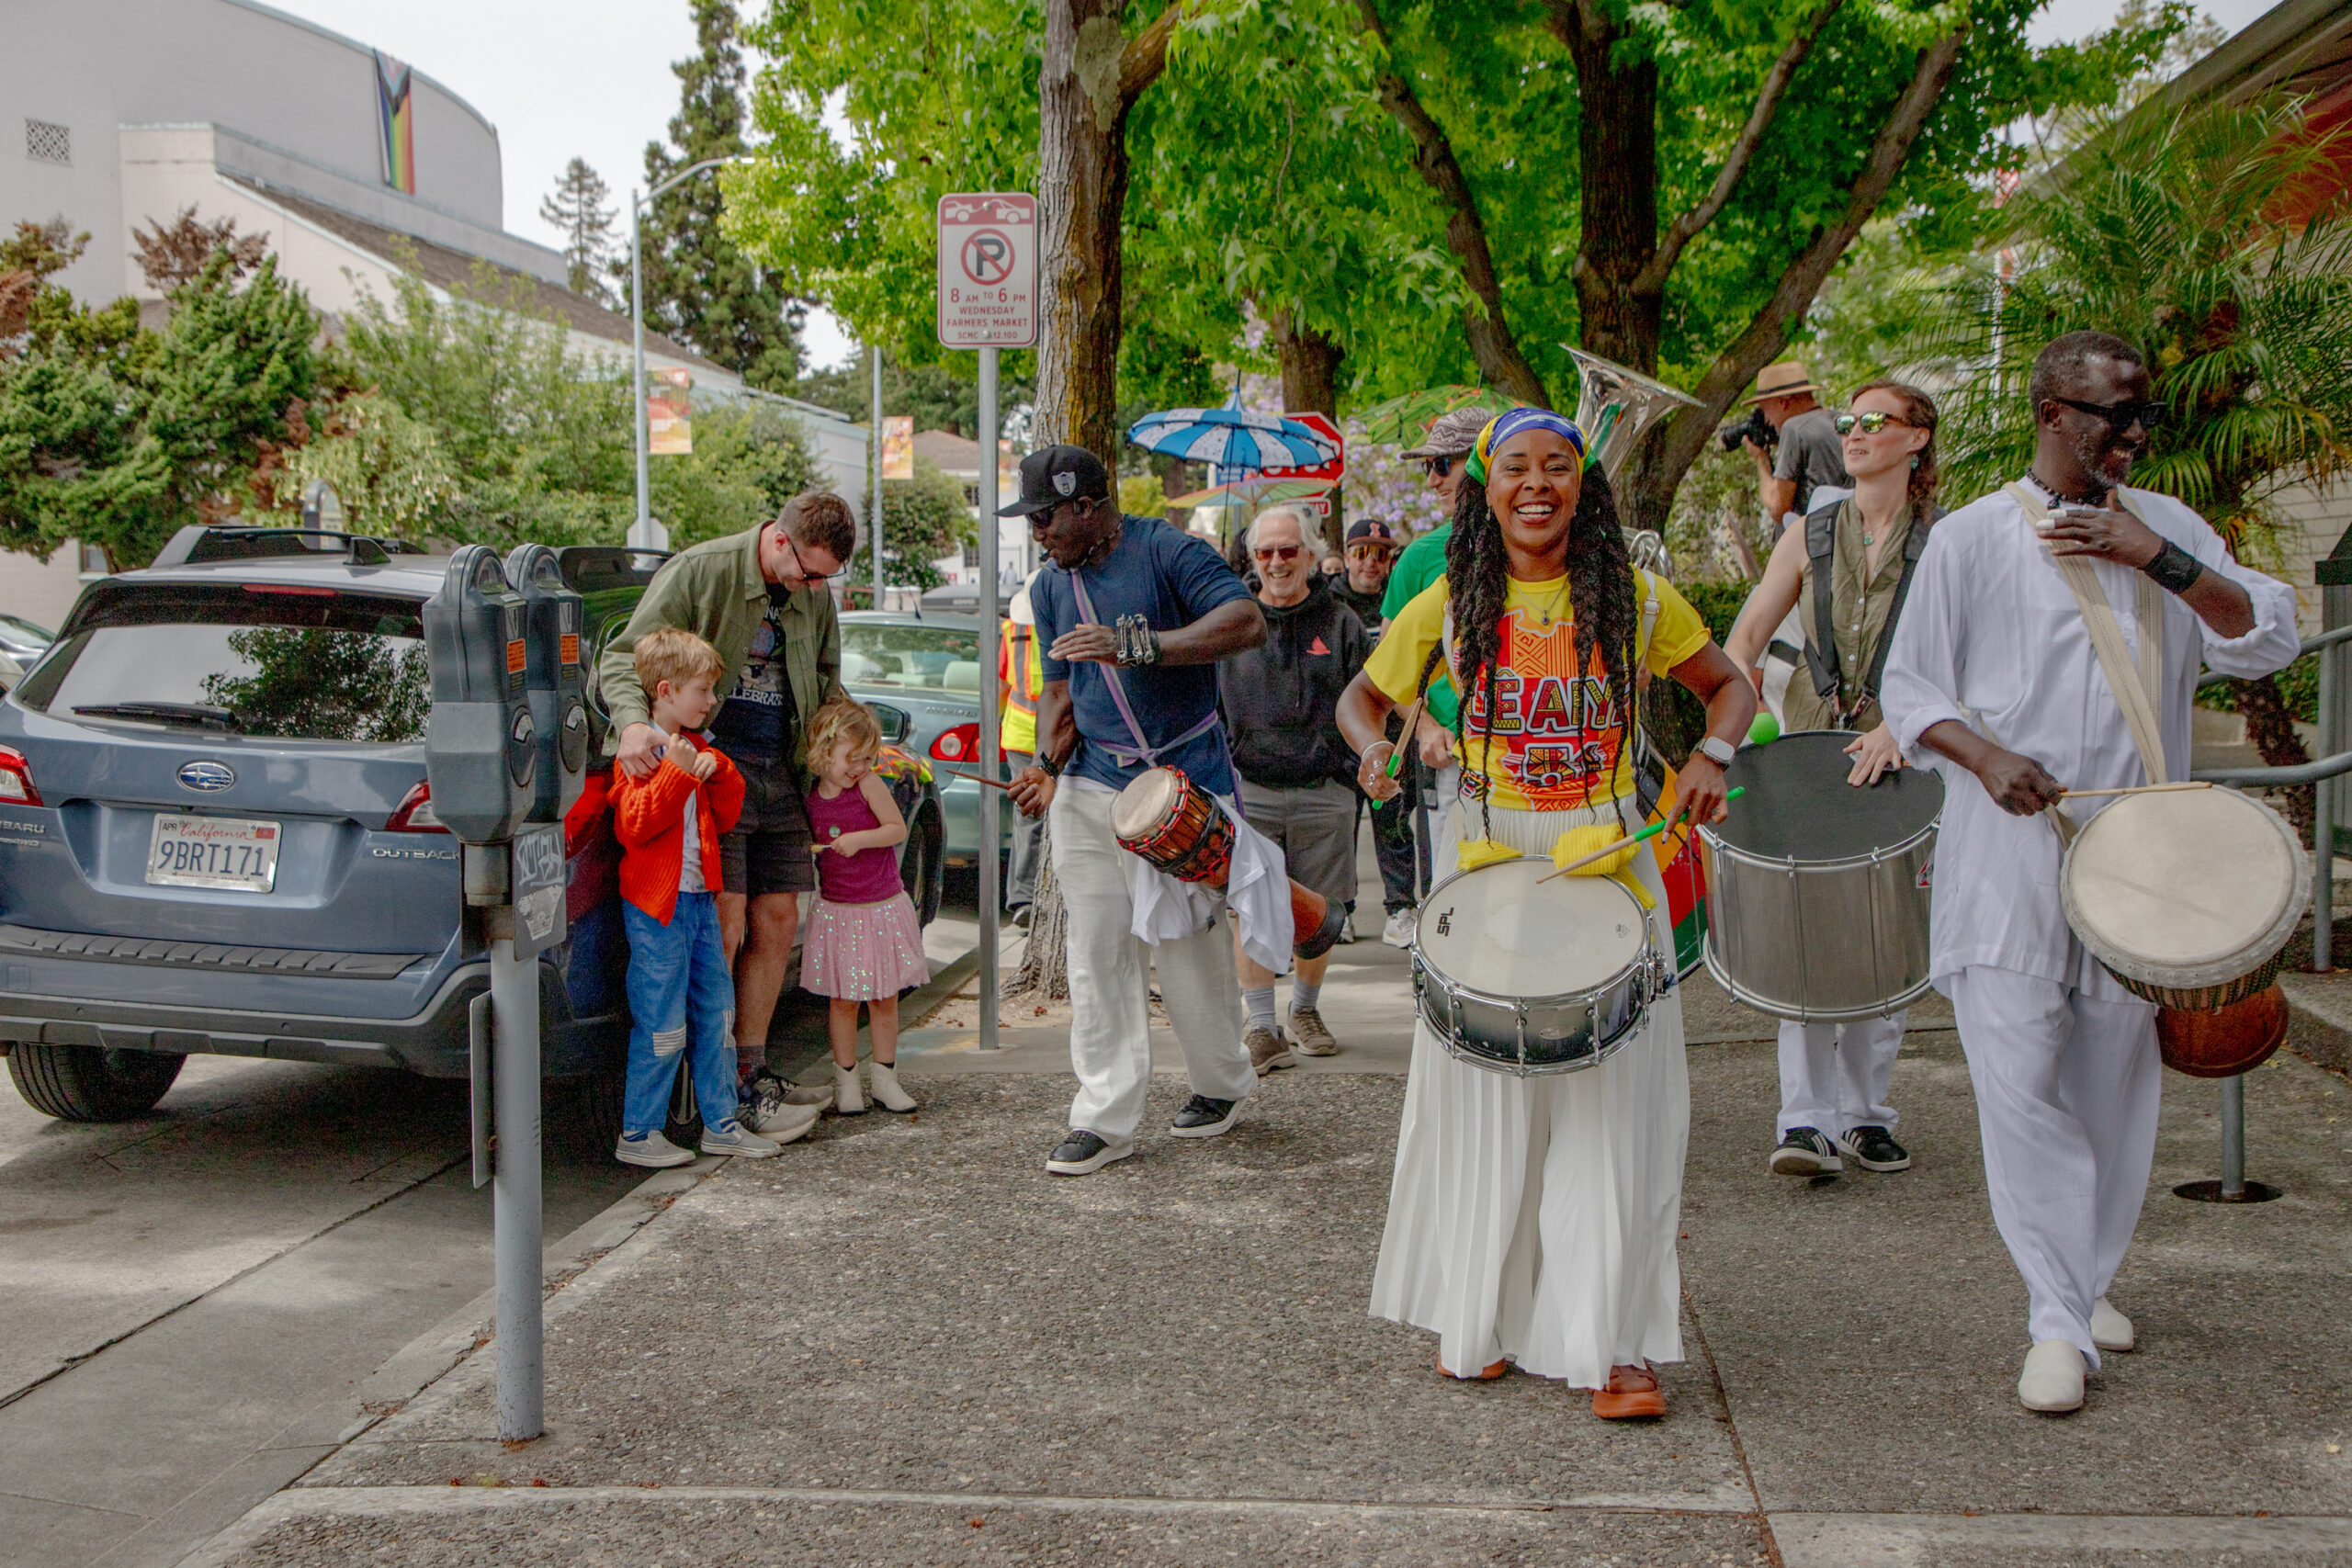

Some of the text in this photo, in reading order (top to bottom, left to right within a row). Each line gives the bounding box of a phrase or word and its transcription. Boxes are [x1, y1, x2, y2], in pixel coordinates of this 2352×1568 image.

[951, 288, 959, 303] 8
[966, 295, 978, 303] AM
[999, 288, 1007, 303] 6
[1013, 294, 1026, 302] PM
[959, 306, 1015, 315] WEDNESDAY
[946, 318, 1028, 327] FARMERS MARKET
[0, 820, 45, 833] BARU
[180, 822, 255, 842] California
[157, 840, 265, 876] 9BRT171
[1437, 908, 1454, 937] SPL
